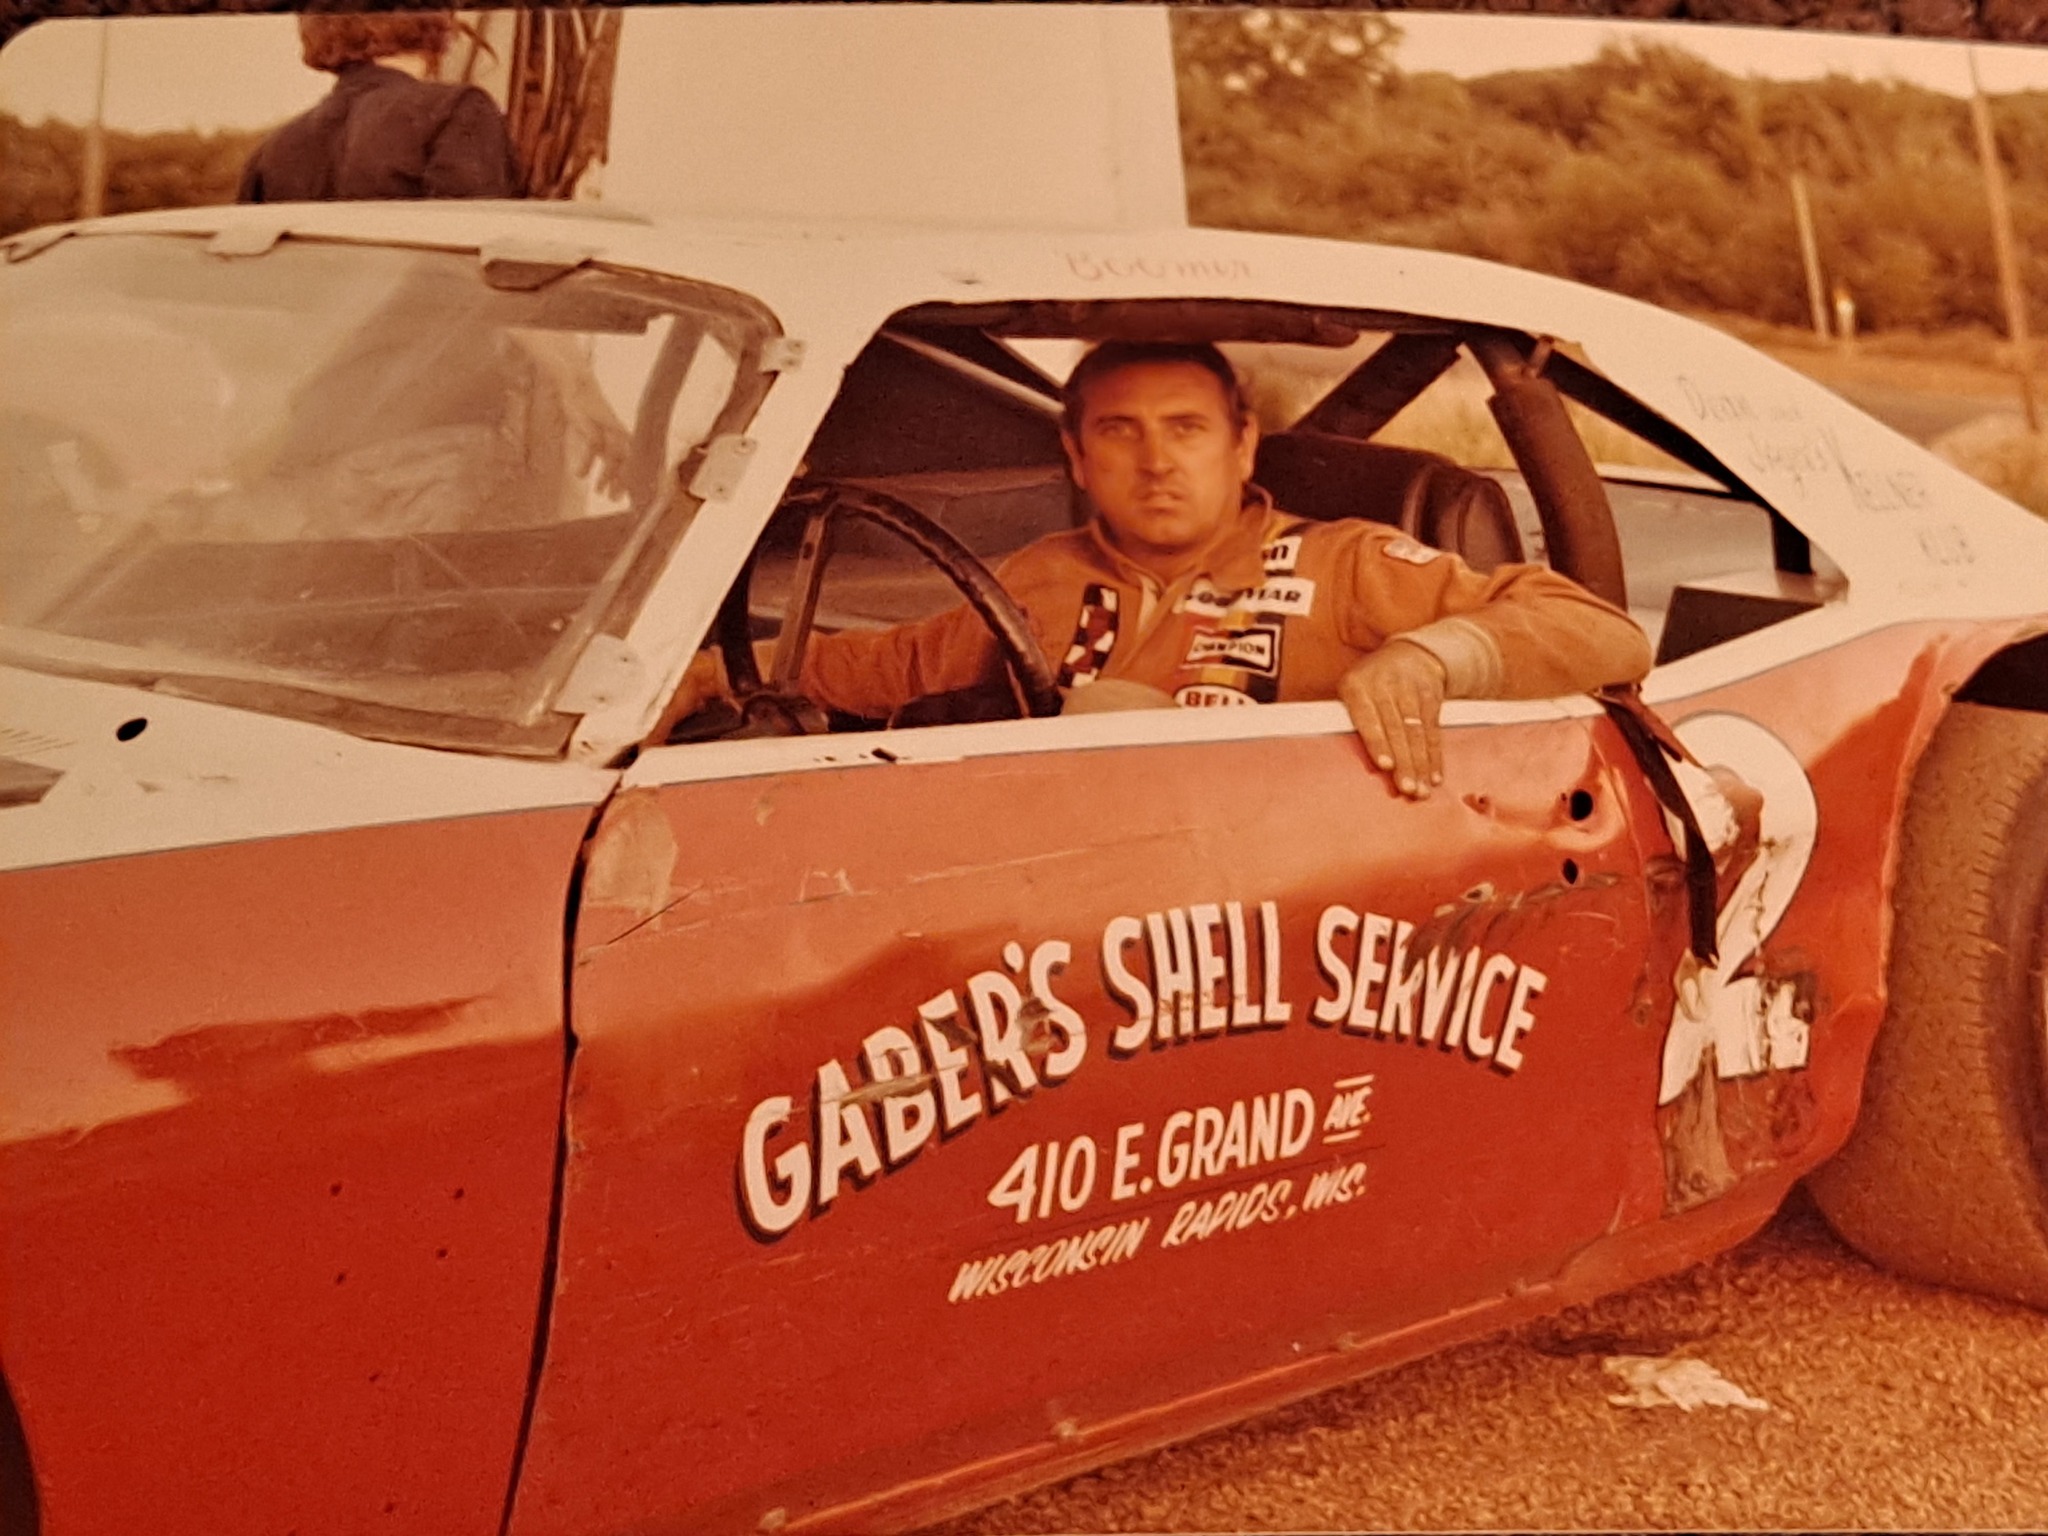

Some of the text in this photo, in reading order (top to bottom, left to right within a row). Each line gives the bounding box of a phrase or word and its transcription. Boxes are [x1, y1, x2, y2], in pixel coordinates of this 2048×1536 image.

[741, 900, 1548, 1234] GABER'S SHELL SERVICE
[986, 1134, 1098, 1223] 410
[947, 1216, 1150, 1303] WISCONSIN
